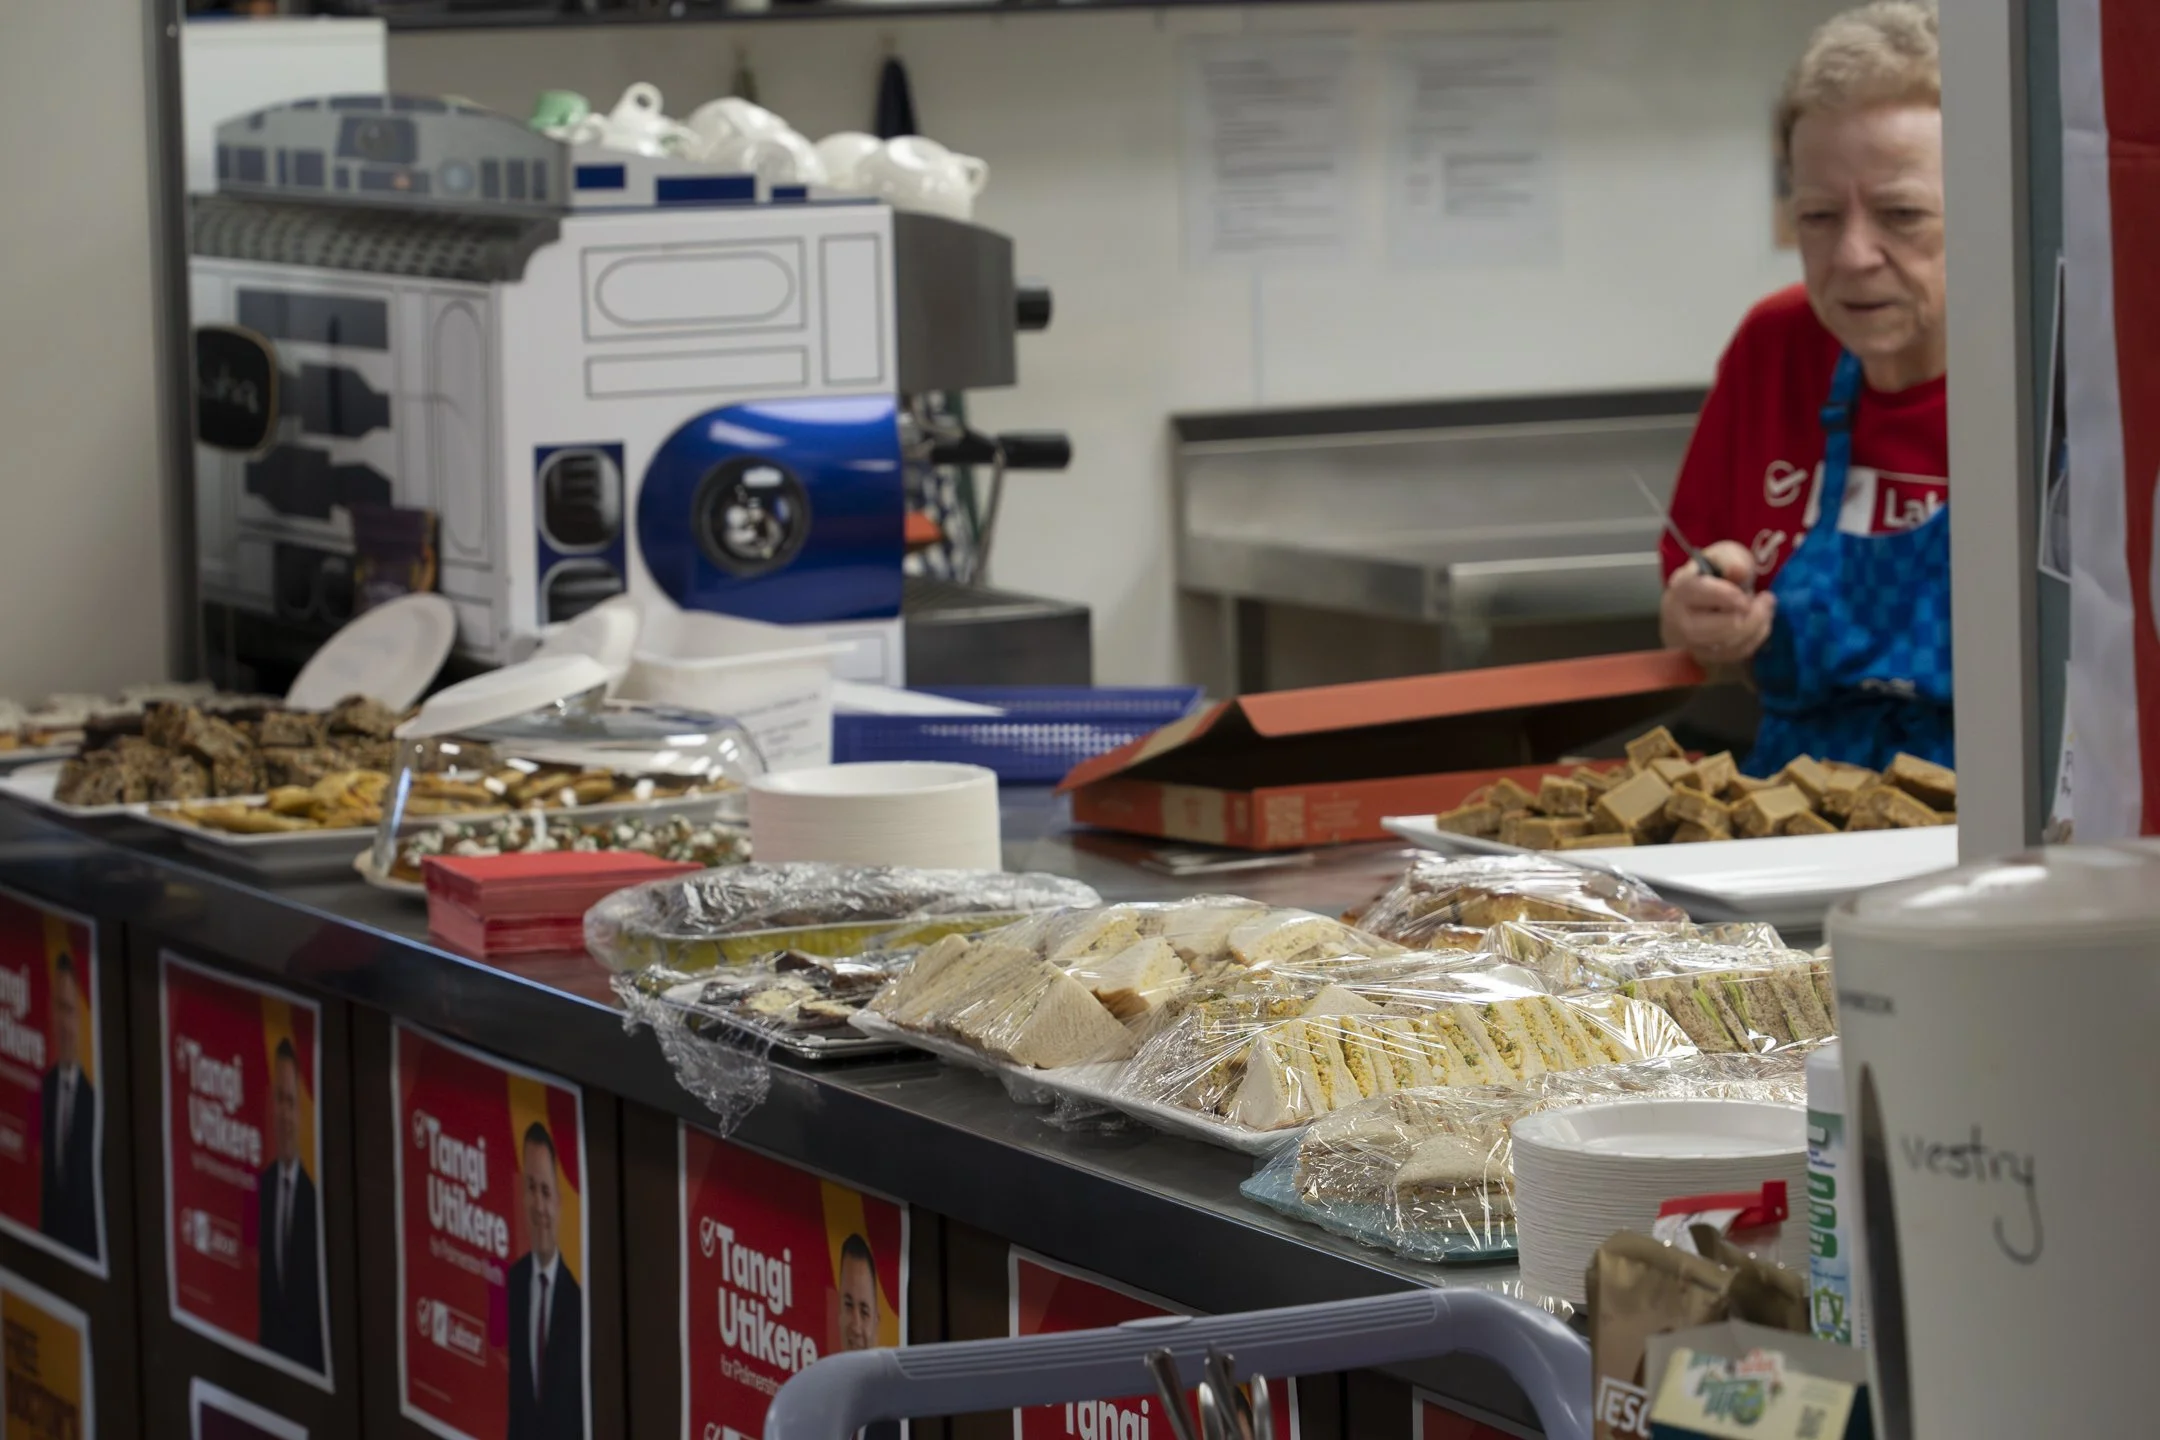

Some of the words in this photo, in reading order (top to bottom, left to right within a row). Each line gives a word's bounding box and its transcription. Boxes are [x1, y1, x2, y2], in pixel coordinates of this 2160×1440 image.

[425, 1115, 488, 1198] Tangi
[1900, 1123, 2044, 1266] vestry
[427, 1173, 510, 1259] Utikere
[716, 1222, 793, 1316] Tangi
[718, 1286, 818, 1374] Utikere
